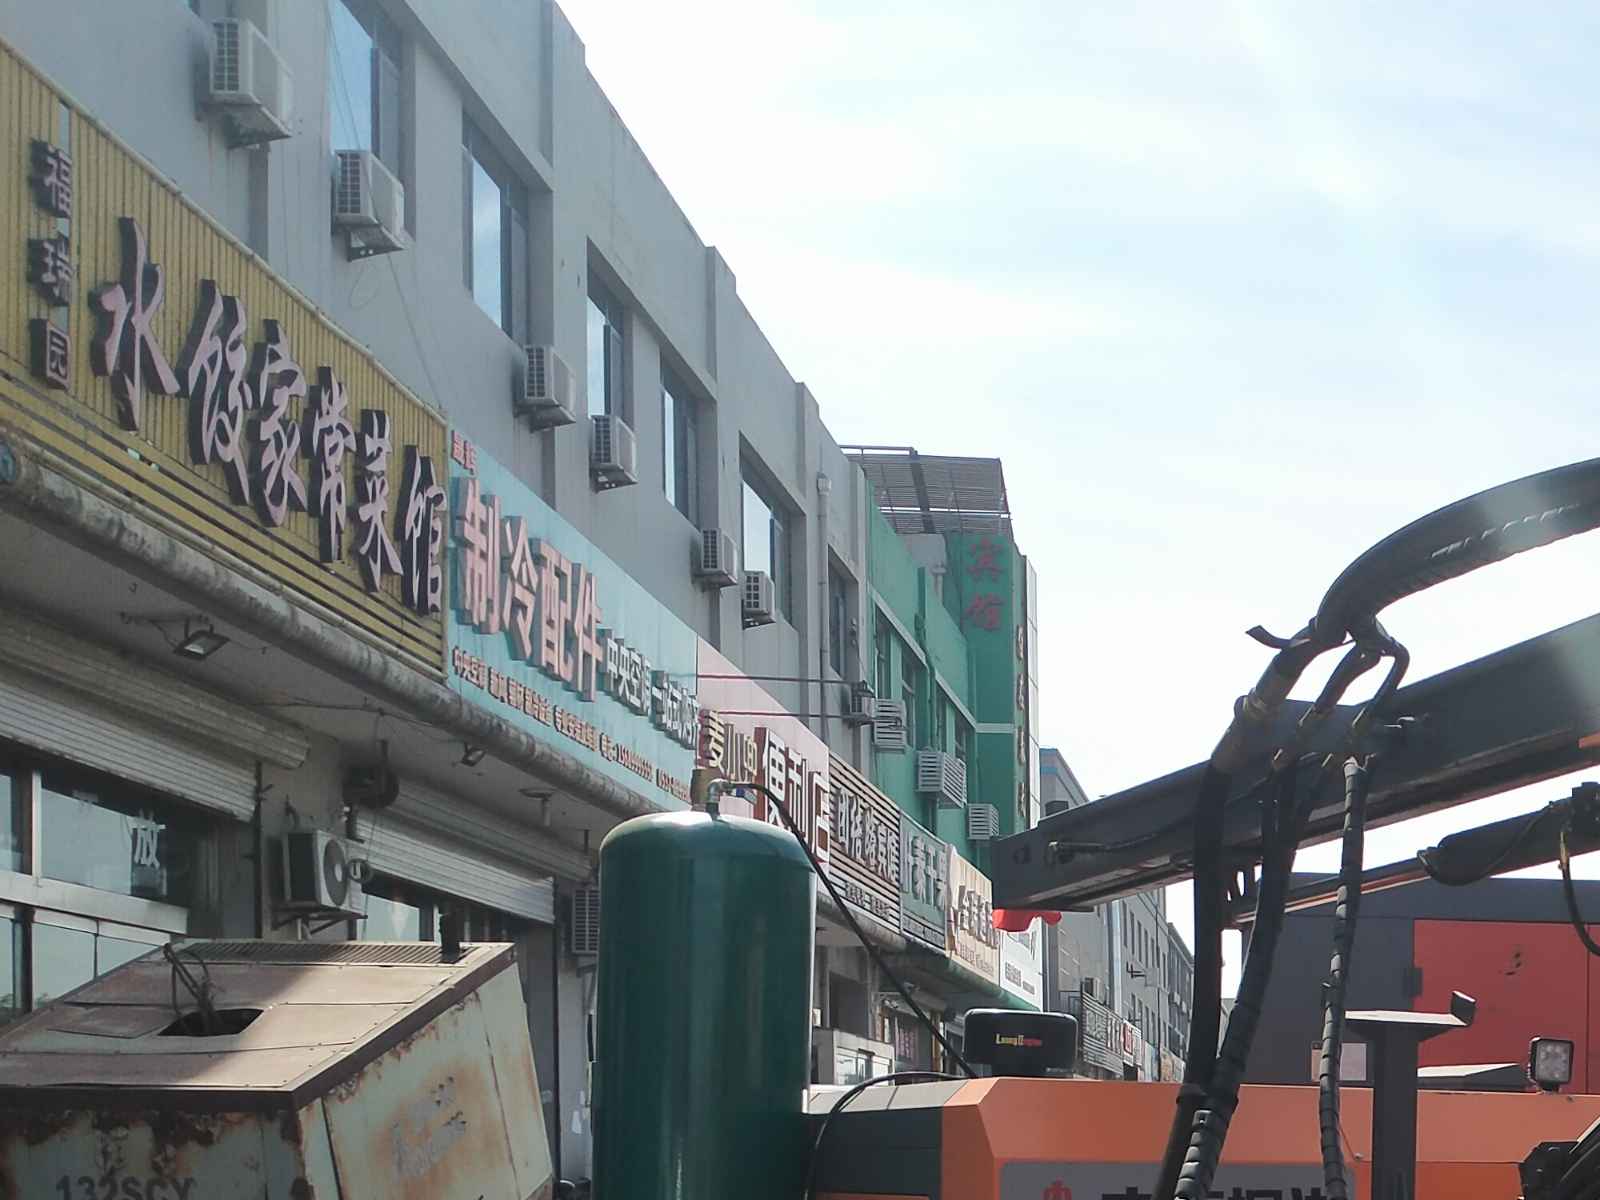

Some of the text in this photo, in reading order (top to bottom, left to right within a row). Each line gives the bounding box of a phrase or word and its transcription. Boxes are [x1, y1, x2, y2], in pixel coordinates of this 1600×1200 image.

[37, 139, 74, 392] 福瑞园
[94, 217, 448, 615] 水饺家常菜馆
[455, 477, 605, 703] 制冷配件
[762, 727, 830, 863] 便利店
